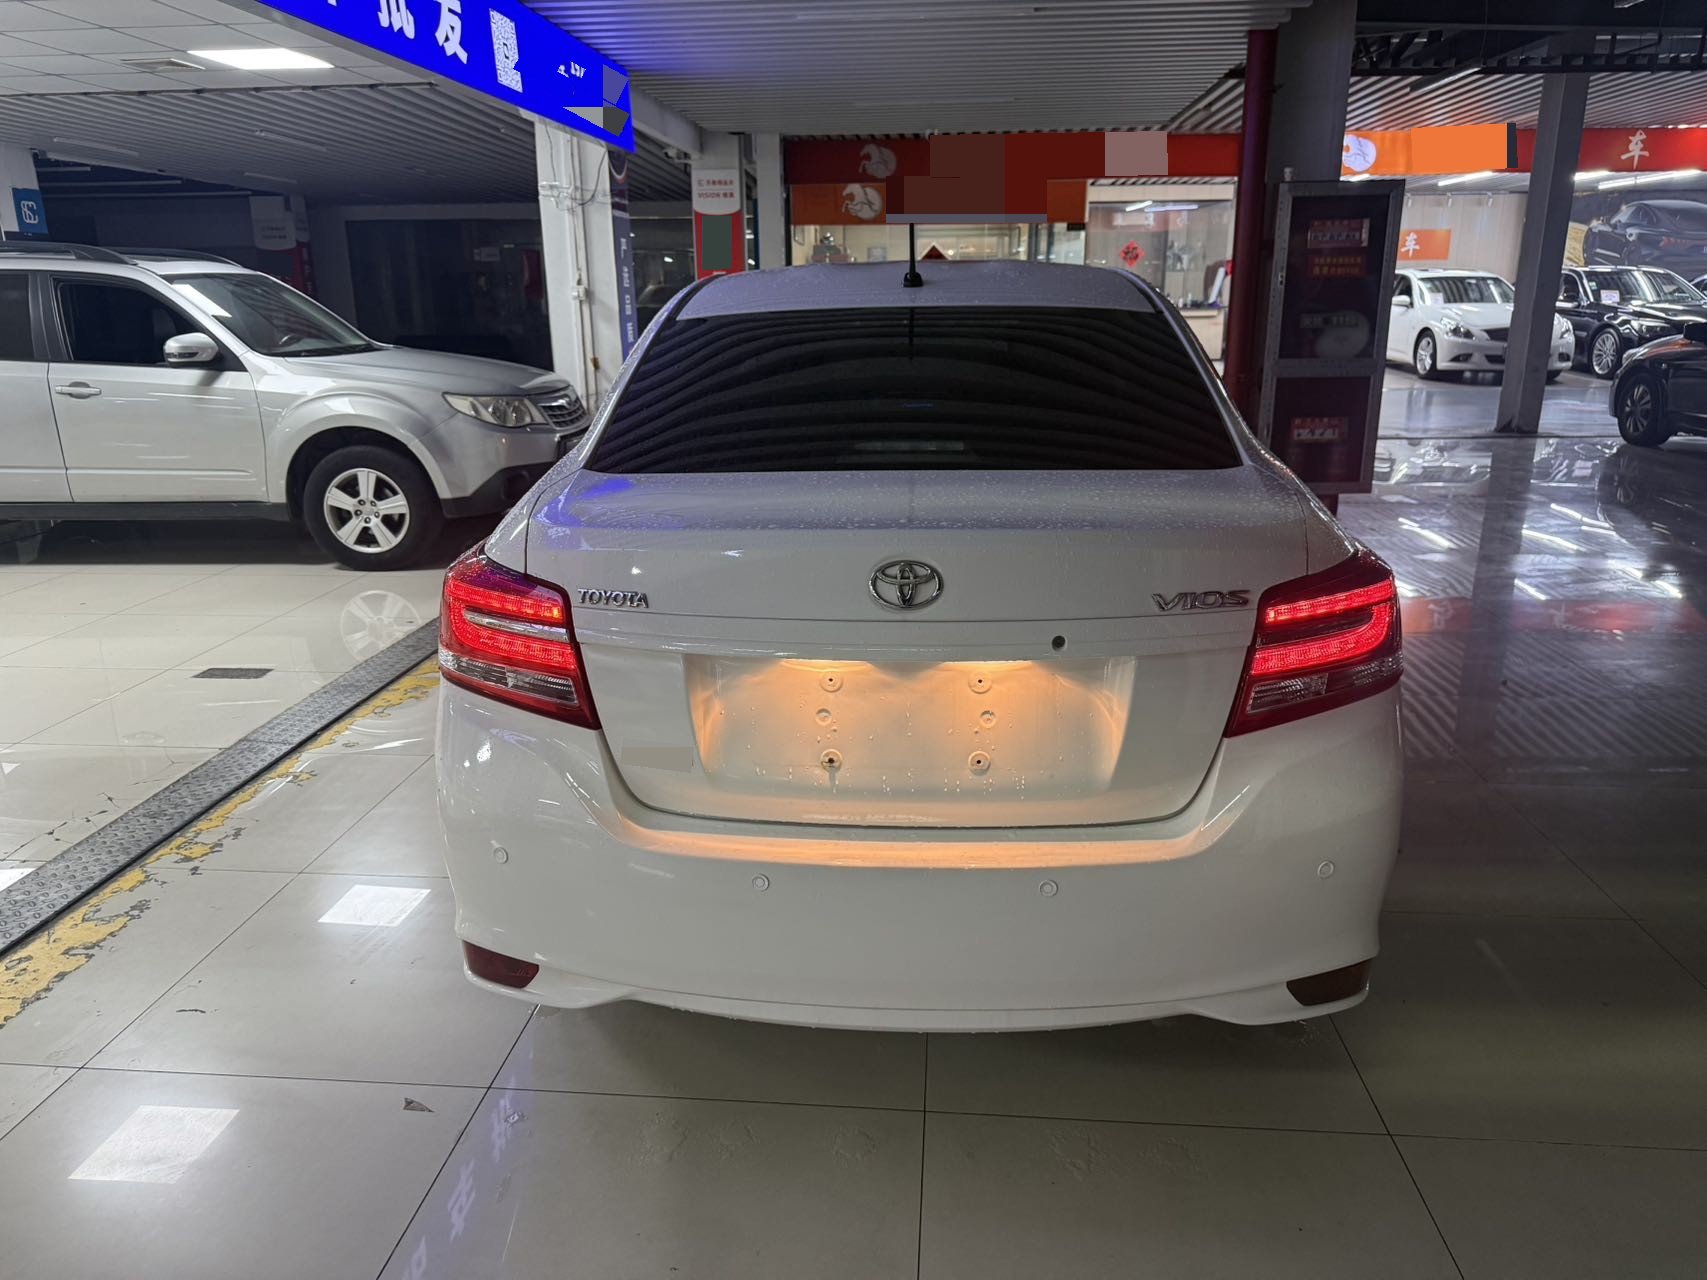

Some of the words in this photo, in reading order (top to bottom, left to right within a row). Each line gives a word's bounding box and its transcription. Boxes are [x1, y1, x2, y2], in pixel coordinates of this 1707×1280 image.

[1620, 129, 1649, 170] 车
[1400, 232, 1420, 258] 车
[577, 588, 649, 608] TOYOTA
[1151, 590, 1249, 611] VIOS
